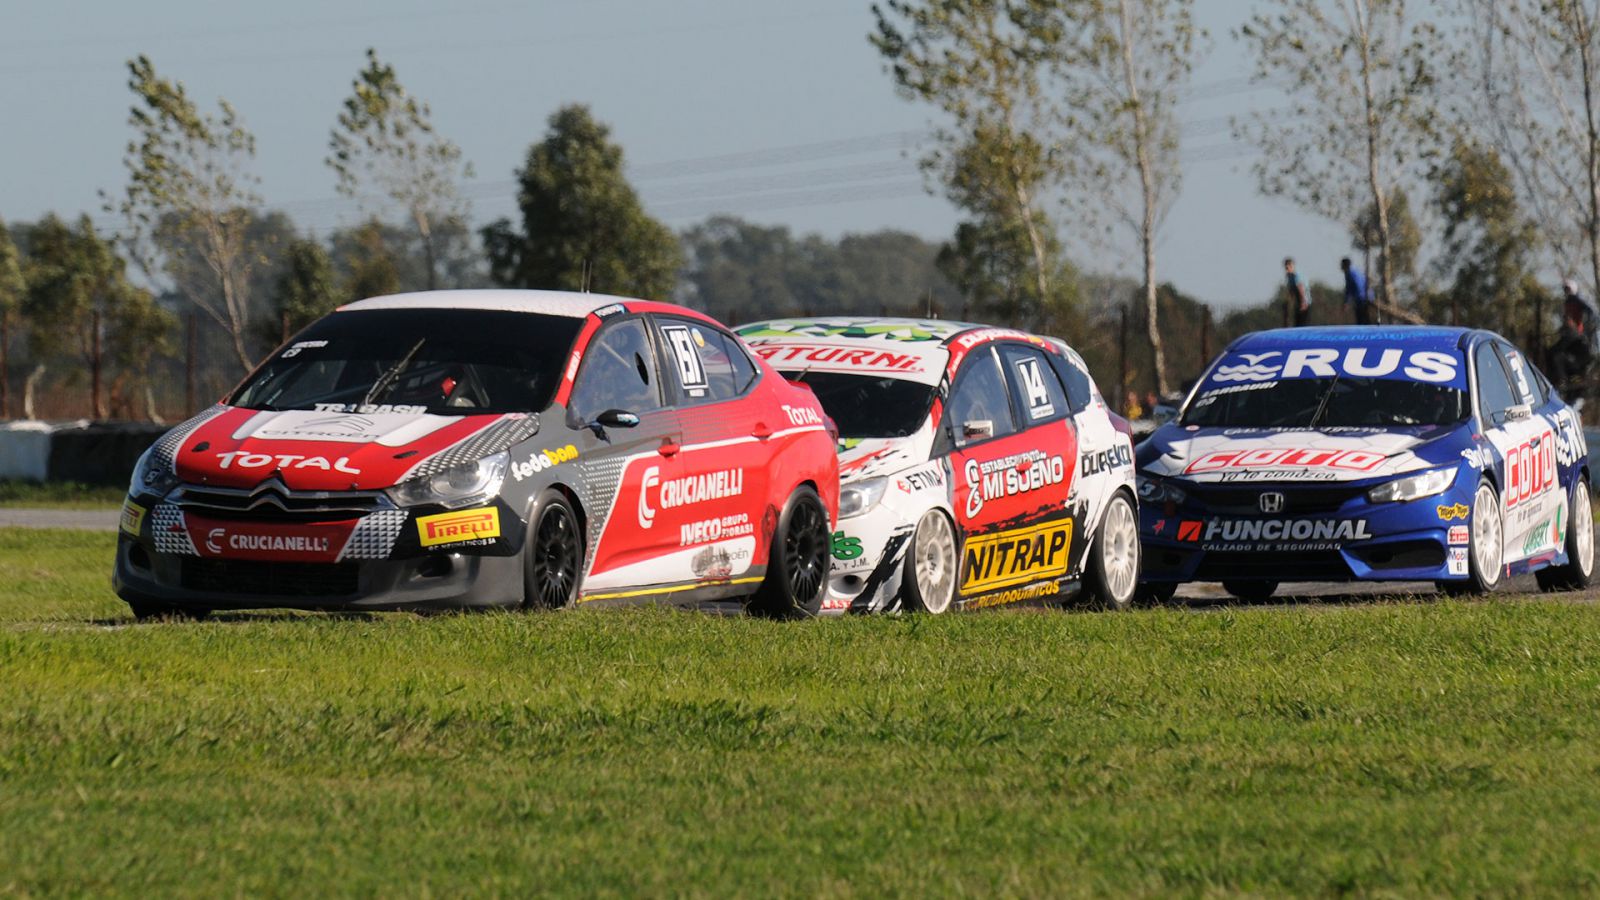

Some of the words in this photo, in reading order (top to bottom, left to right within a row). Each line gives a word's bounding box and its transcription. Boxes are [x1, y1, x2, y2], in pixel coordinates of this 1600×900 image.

[1281, 348, 1458, 382] RUS
[1019, 360, 1049, 407] 14
[782, 405, 822, 426] TOTAL
[215, 451, 361, 475] TOTAL
[1185, 449, 1388, 474] COTO
[1506, 430, 1554, 507] COTO
[660, 468, 743, 509] CRUCIANELLI
[983, 471, 1004, 501] MI
[1219, 472, 1239, 483] Yo
[426, 514, 493, 539] PIRELLI
[680, 518, 721, 547] IVECO
[721, 513, 749, 527] GRUPO
[1204, 520, 1372, 540] FUNCIONAL
[230, 535, 328, 552] CRUCIANELLI
[1201, 543, 1251, 551] CALZADO
[1256, 543, 1271, 551] DE
[963, 530, 1066, 583] NITRAP
